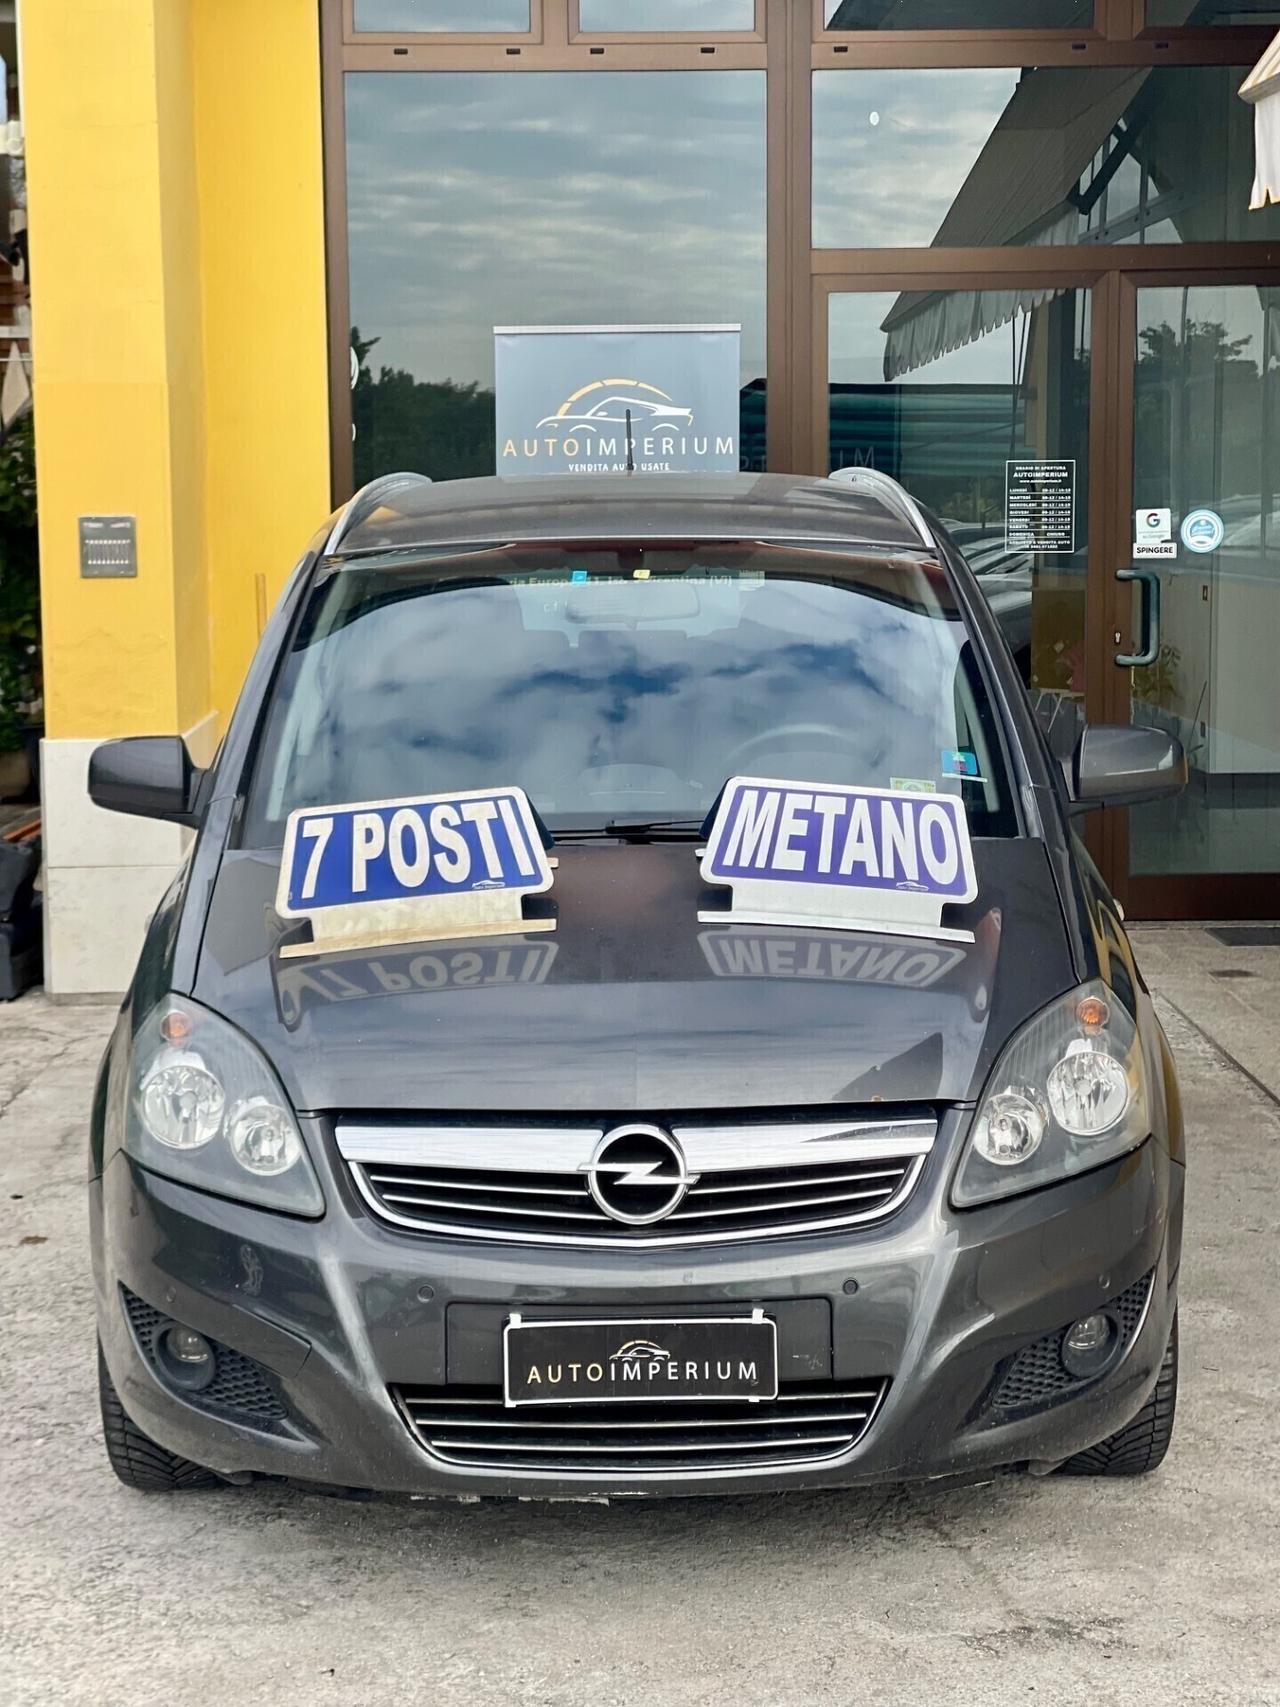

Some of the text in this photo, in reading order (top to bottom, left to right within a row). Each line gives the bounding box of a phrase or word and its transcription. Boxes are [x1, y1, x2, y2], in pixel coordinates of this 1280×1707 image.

[503, 437, 733, 457] AUTOIMPERIUM
[568, 463, 609, 472] VENDITA
[641, 462, 670, 471] USATE
[1136, 546, 1173, 554] SPINGERE
[722, 790, 959, 885] METANO
[301, 800, 536, 899] 7 POSTI
[526, 1360, 758, 1384] AUTOIMPERIUM
